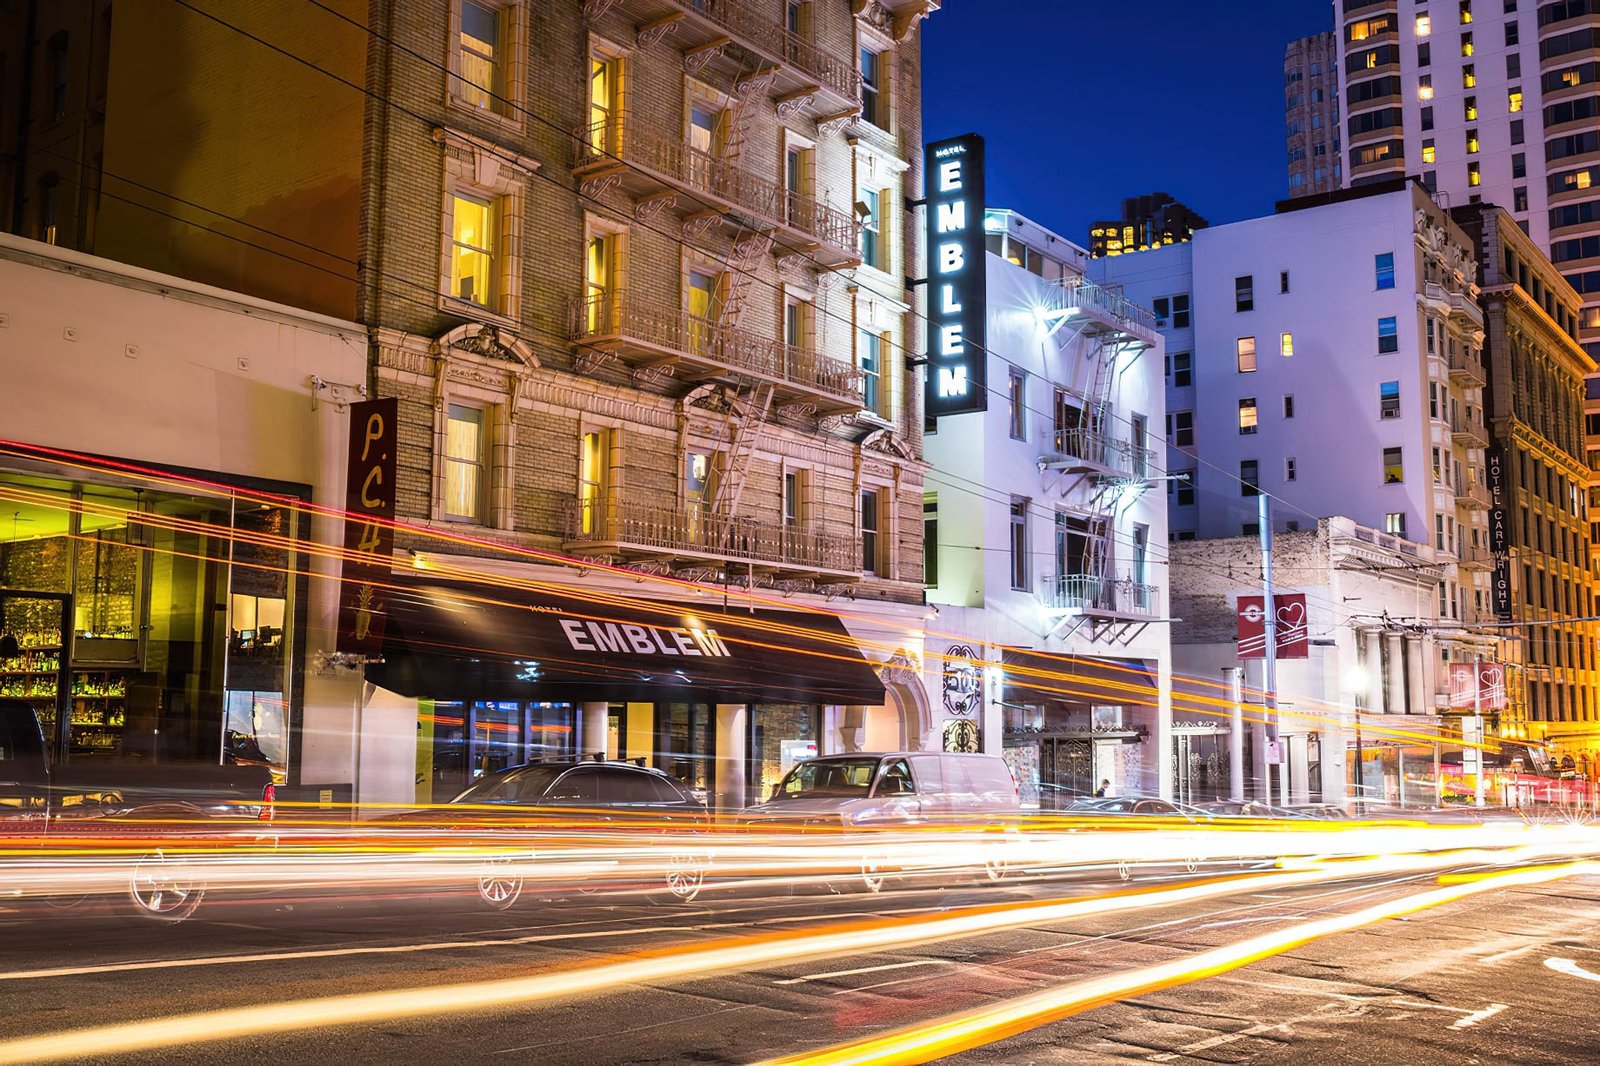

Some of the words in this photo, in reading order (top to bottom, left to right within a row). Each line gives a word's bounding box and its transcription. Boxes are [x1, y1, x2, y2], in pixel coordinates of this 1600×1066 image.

[936, 145, 967, 158] HOTEL
[937, 160, 967, 398] EMBLEM
[1490, 456, 1502, 505] HOTEL
[1494, 511, 1507, 609] CARTWRIGHT
[558, 619, 731, 657] EMBLEM
